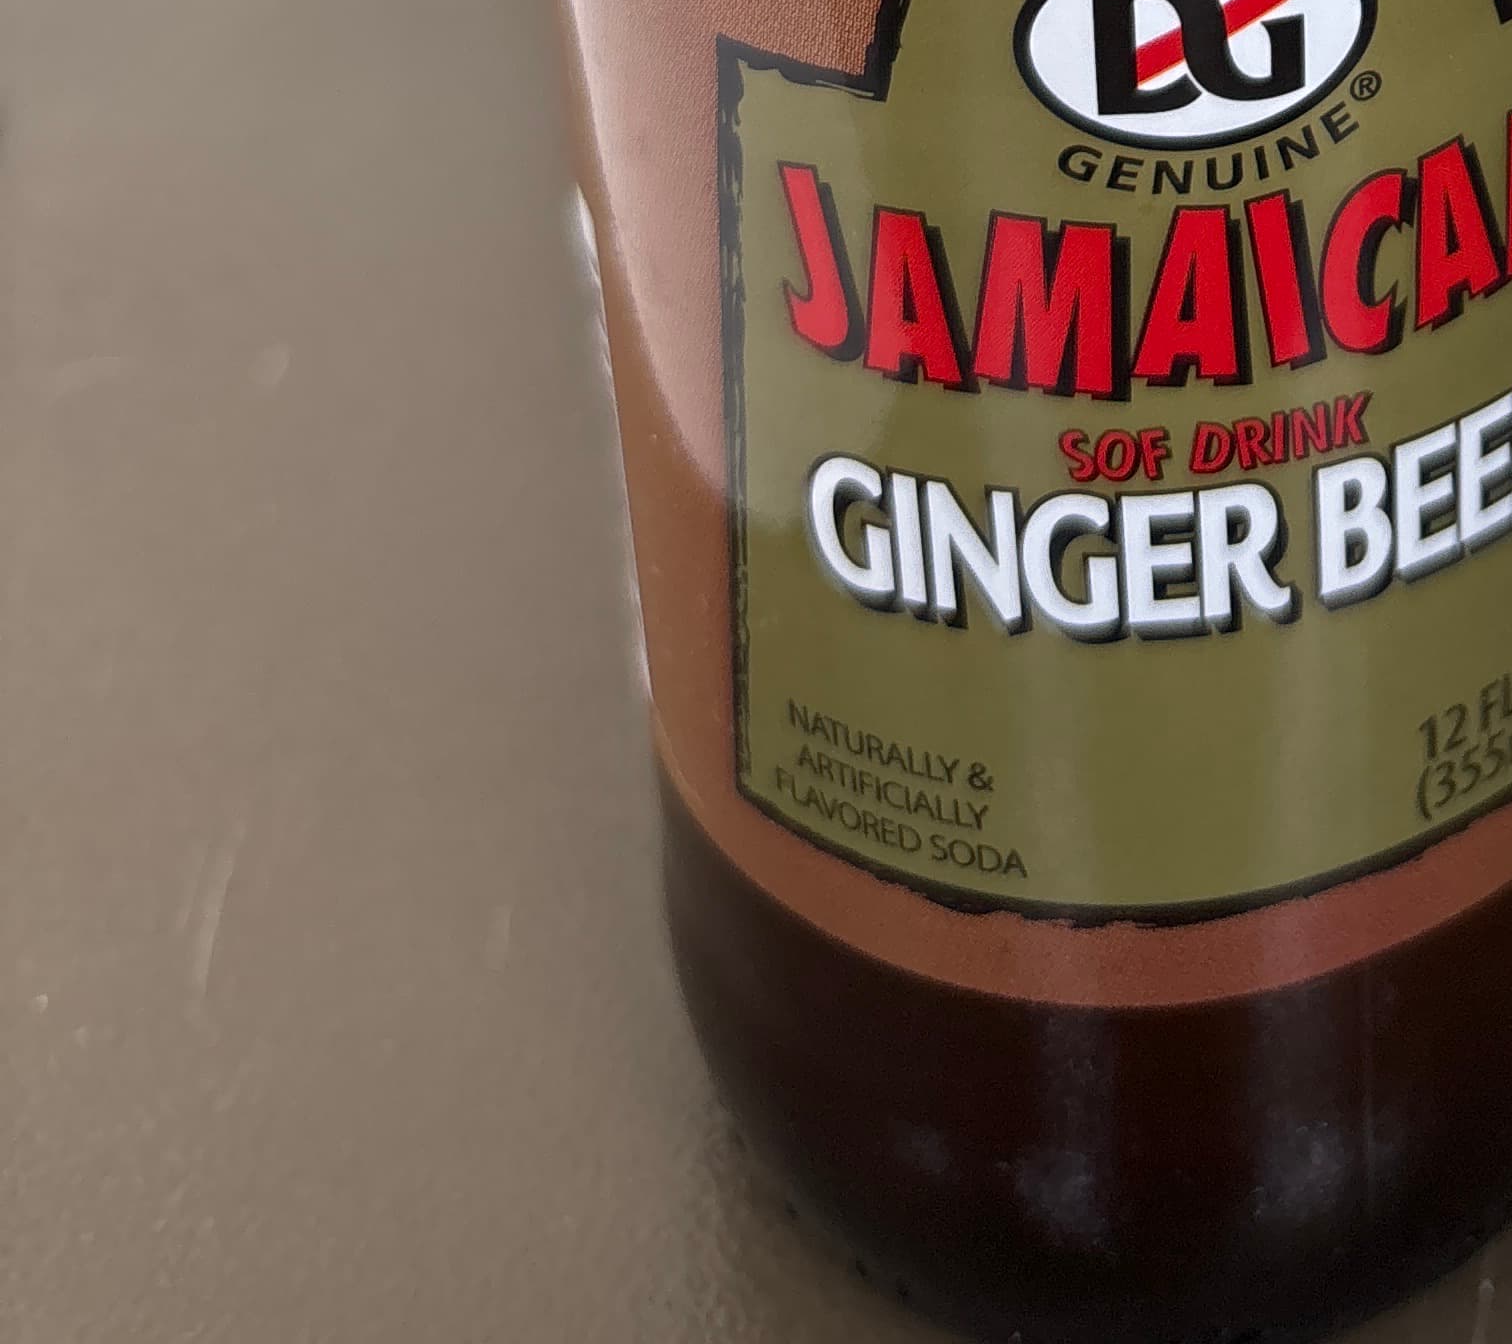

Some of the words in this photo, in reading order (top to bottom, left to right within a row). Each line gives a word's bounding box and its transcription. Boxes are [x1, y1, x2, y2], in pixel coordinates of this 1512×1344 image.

[1057, 101, 1361, 195] GENUINE
[1058, 425, 1174, 483] SOF
[1188, 391, 1373, 475] DRINK
[805, 450, 1304, 642] GINGER
[786, 696, 961, 785] NATURALLY
[967, 761, 995, 792] &
[1418, 703, 1469, 761] 12
[774, 764, 923, 854] FLAVORED
[929, 833, 1029, 880] SODA
[796, 743, 990, 831] ARTIFICIALLY
